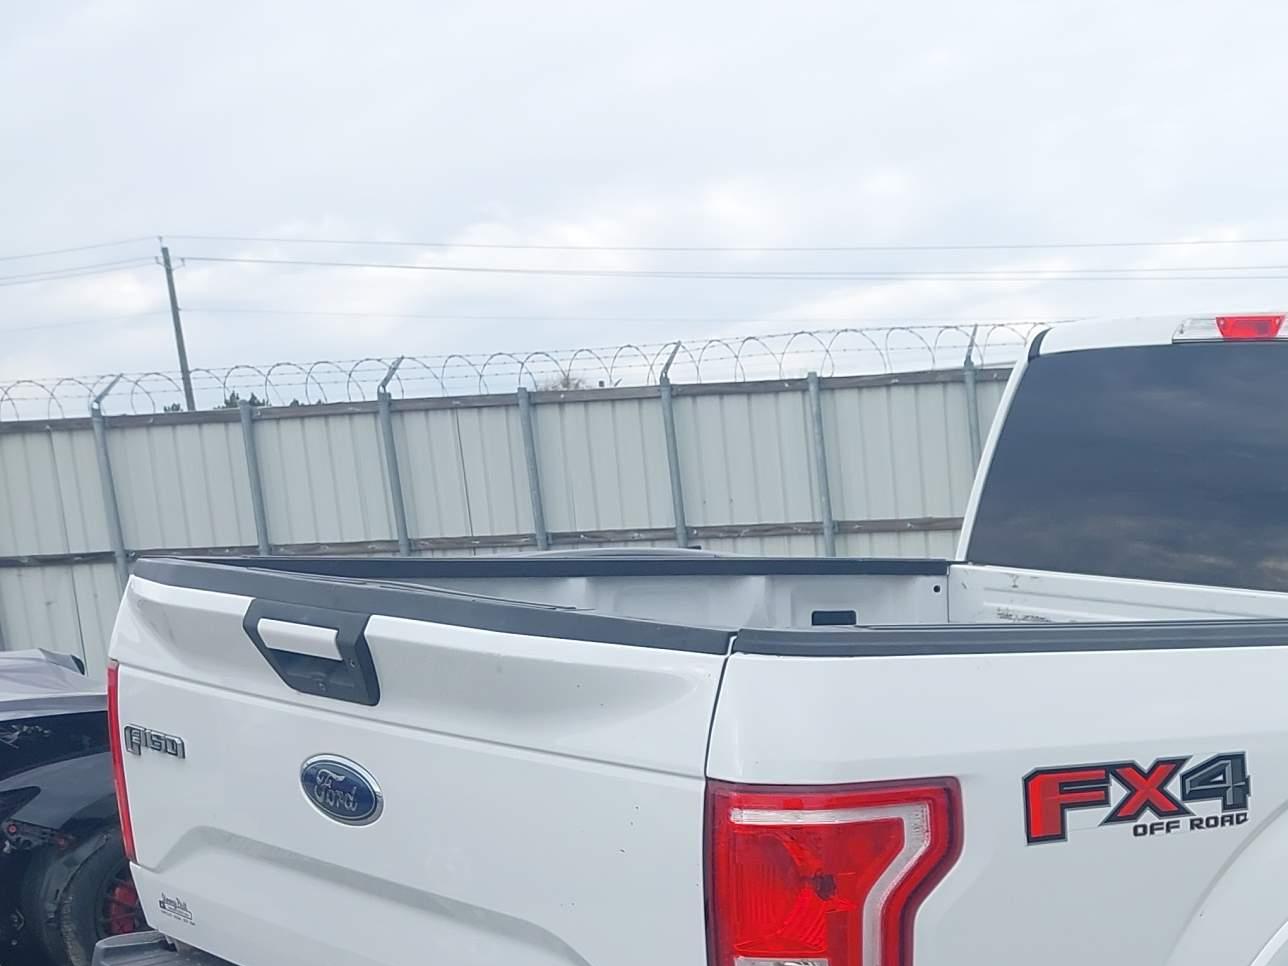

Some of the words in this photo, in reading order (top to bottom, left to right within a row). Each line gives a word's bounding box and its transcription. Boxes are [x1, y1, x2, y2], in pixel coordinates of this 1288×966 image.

[313, 768, 359, 812] Ford
[1021, 750, 1251, 846] FX4
[1133, 820, 1181, 837] OFF
[1189, 812, 1249, 831] ROAD
